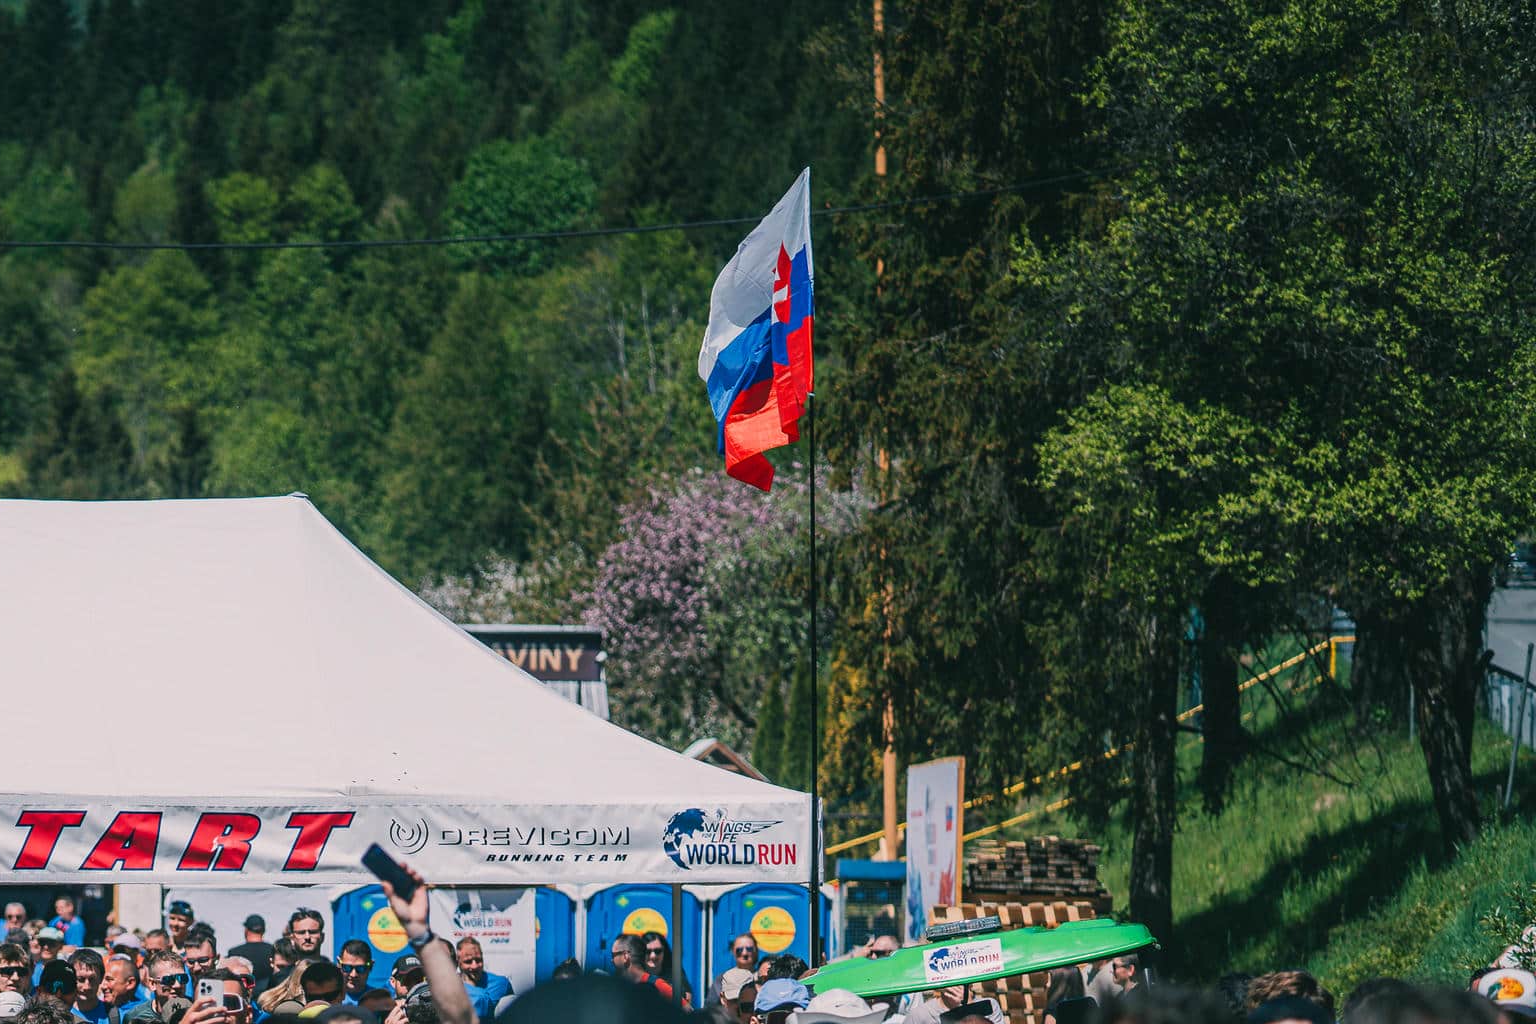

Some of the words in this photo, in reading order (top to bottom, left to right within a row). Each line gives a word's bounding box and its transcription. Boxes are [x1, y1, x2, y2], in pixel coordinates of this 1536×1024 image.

[704, 821, 752, 833] WINGS
[438, 826, 630, 846] DREVICOM
[711, 833, 738, 843] LIFE
[486, 854, 565, 862] RUNNING
[574, 854, 628, 862] TEAM
[686, 844, 755, 865] WORLD
[758, 844, 797, 865] RUN
[464, 917, 494, 928] WORLD
[941, 956, 977, 970] WORLD
[978, 953, 1000, 963] RUN
